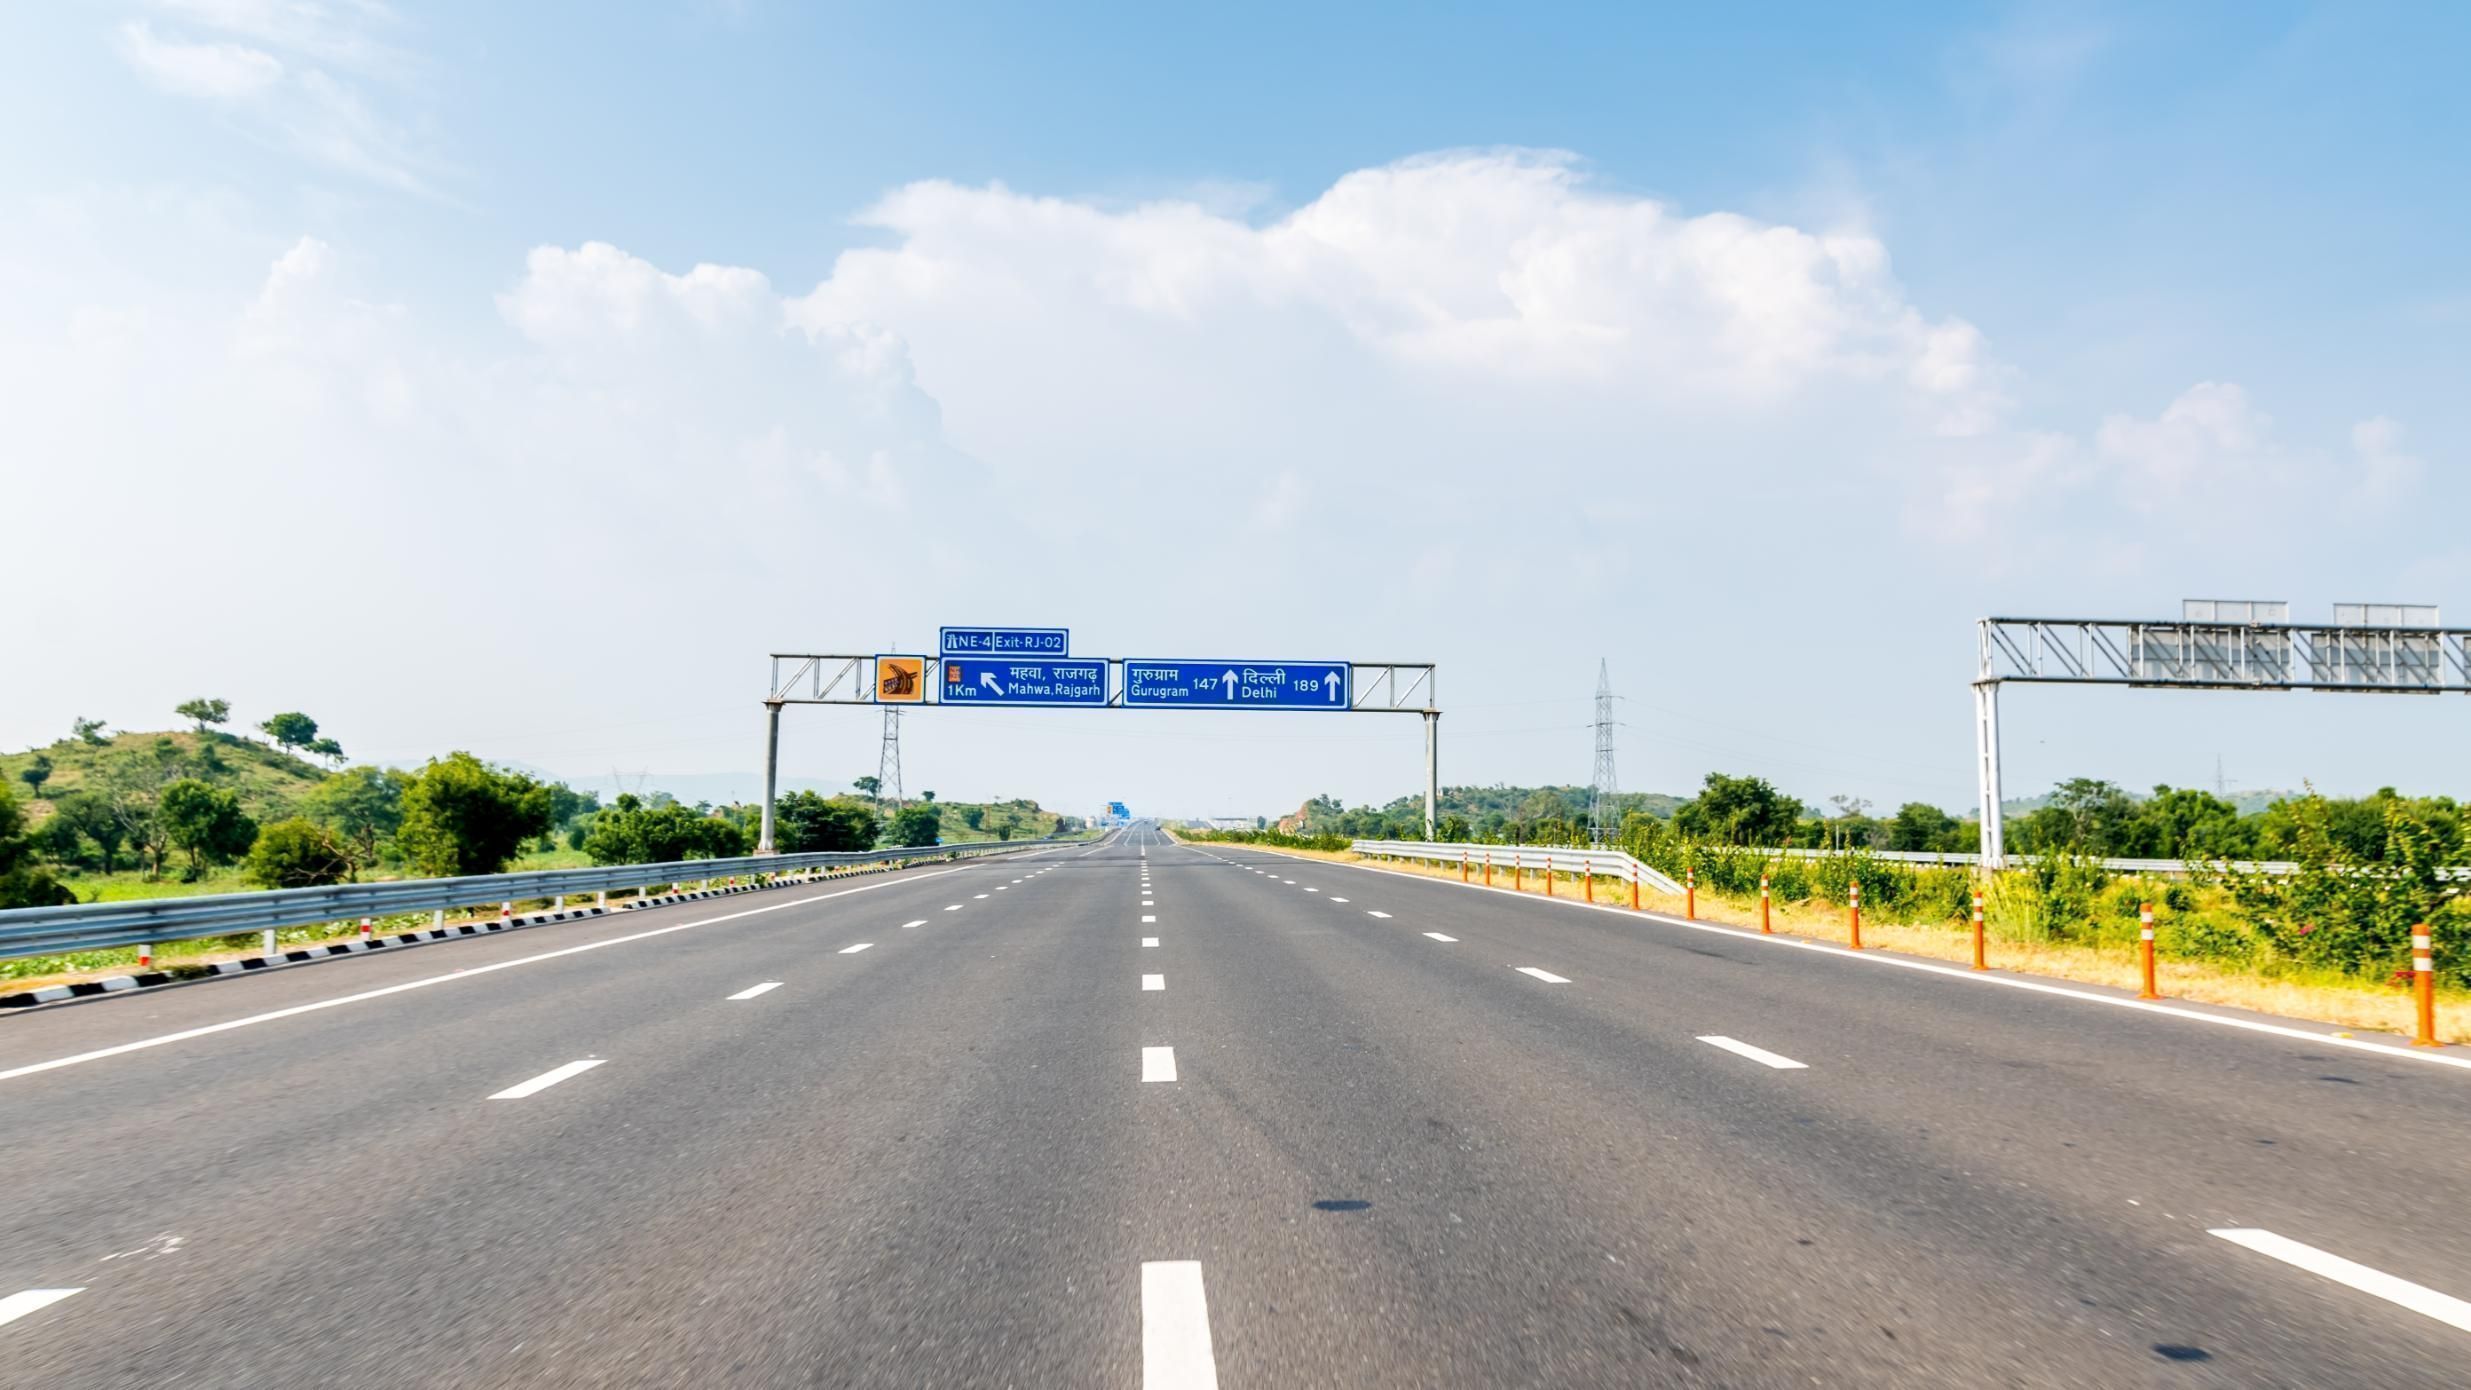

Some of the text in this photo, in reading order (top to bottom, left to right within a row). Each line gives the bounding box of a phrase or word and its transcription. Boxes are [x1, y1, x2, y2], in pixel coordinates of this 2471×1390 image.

[1009, 667, 1098, 683] महवा, राजगढ़
[1242, 668, 1286, 685] दिल्ली
[1193, 678, 1219, 690] 147
[1293, 679, 1319, 692] 189
[1131, 684, 1189, 699] Gurugram
[1242, 686, 1277, 698] Delhi
